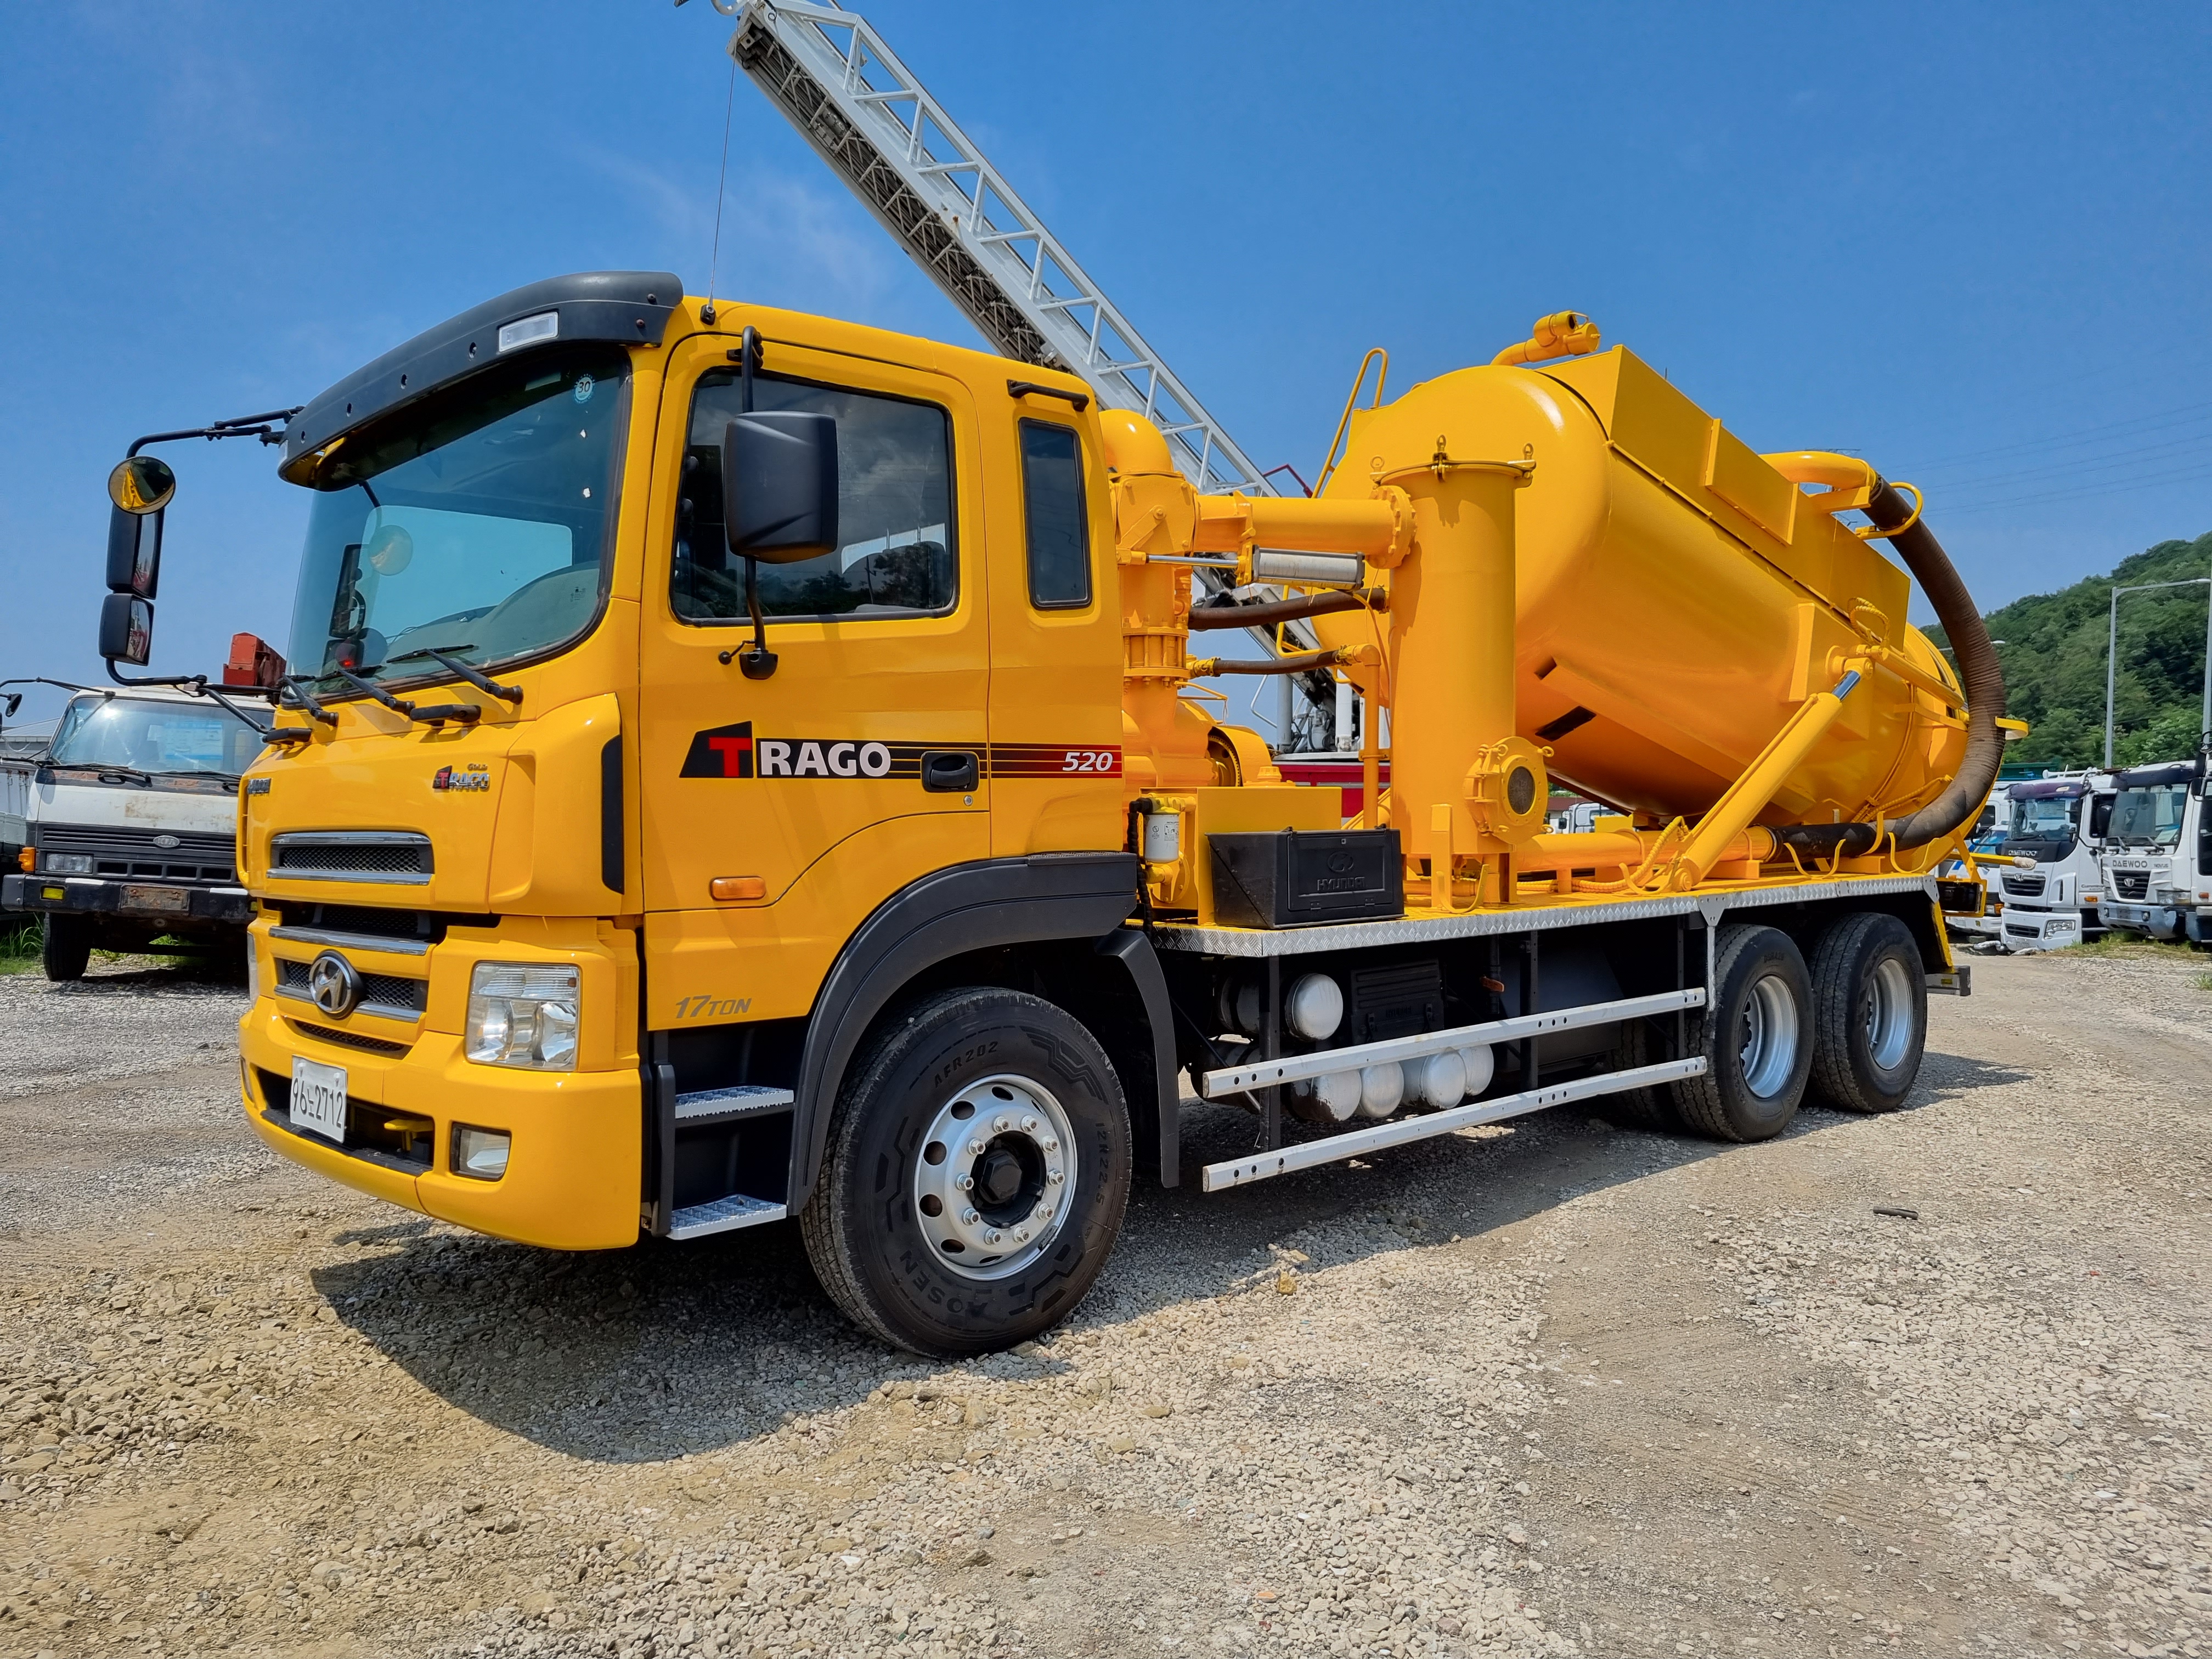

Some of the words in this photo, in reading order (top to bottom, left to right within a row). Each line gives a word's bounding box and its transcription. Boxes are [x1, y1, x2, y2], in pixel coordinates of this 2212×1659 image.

[708, 737, 891, 777] TRAGO
[1062, 752, 1114, 771] 520
[437, 771, 490, 790] TRAGO
[2113, 860, 2148, 868] DAEWOO
[934, 1041, 998, 1088] AFR202
[292, 1077, 343, 1129] 96노2712
